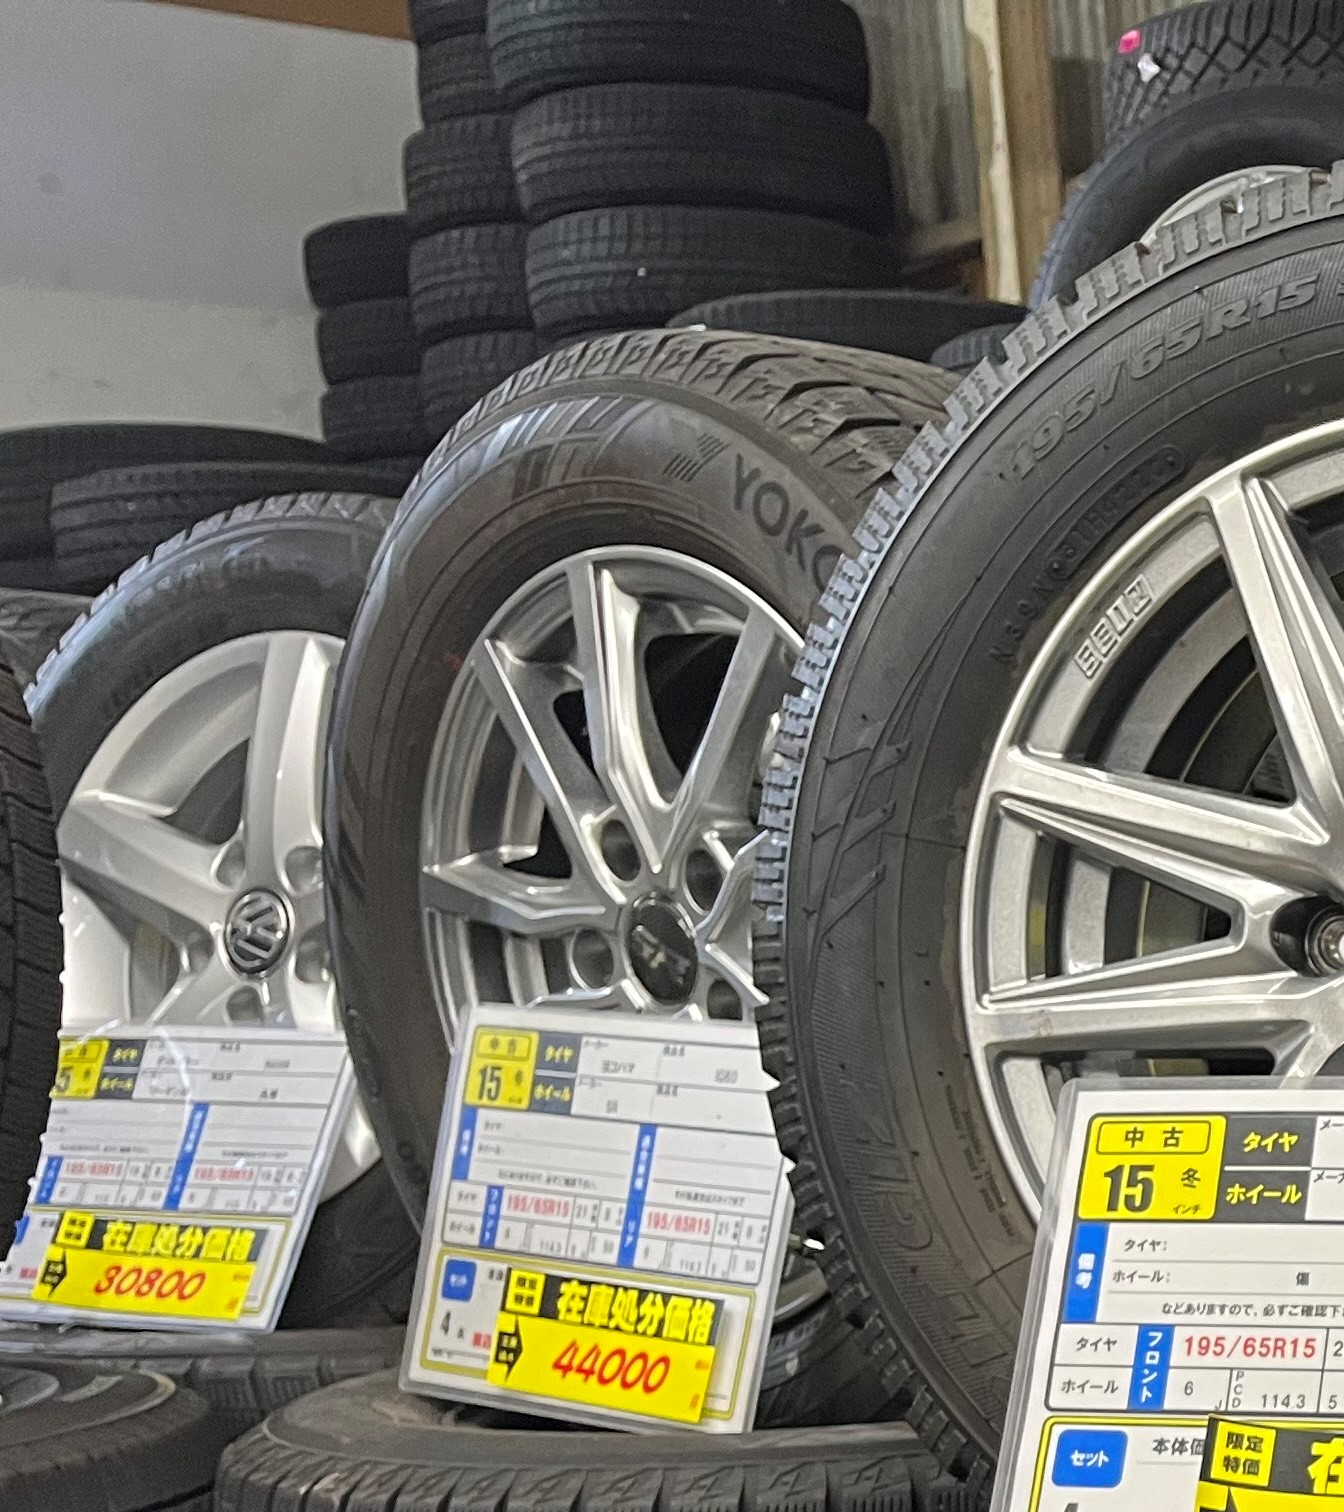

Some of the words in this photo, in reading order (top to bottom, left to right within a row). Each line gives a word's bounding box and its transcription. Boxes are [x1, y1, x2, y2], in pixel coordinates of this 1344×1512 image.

[475, 1064, 503, 1101] 15
[1123, 1126, 1183, 1148] 中古
[1242, 1131, 1298, 1153] タイヤ
[1102, 1163, 1155, 1213] 15
[1180, 1167, 1201, 1188] 冬
[1225, 1183, 1301, 1205] ホイール
[93, 1264, 206, 1300] 30800
[557, 1279, 715, 1344] 在庫処分価格
[1075, 1336, 1117, 1352] タイヤ
[1183, 1334, 1317, 1359] 195/65R15
[551, 1339, 670, 1394] 44000
[1140, 1331, 1162, 1403] フロント
[1060, 1378, 1119, 1394] ホイール
[1183, 1380, 1194, 1396] 6
[1260, 1392, 1306, 1409] 114.3
[1327, 1394, 1338, 1410] 5
[1069, 1449, 1109, 1467] セット
